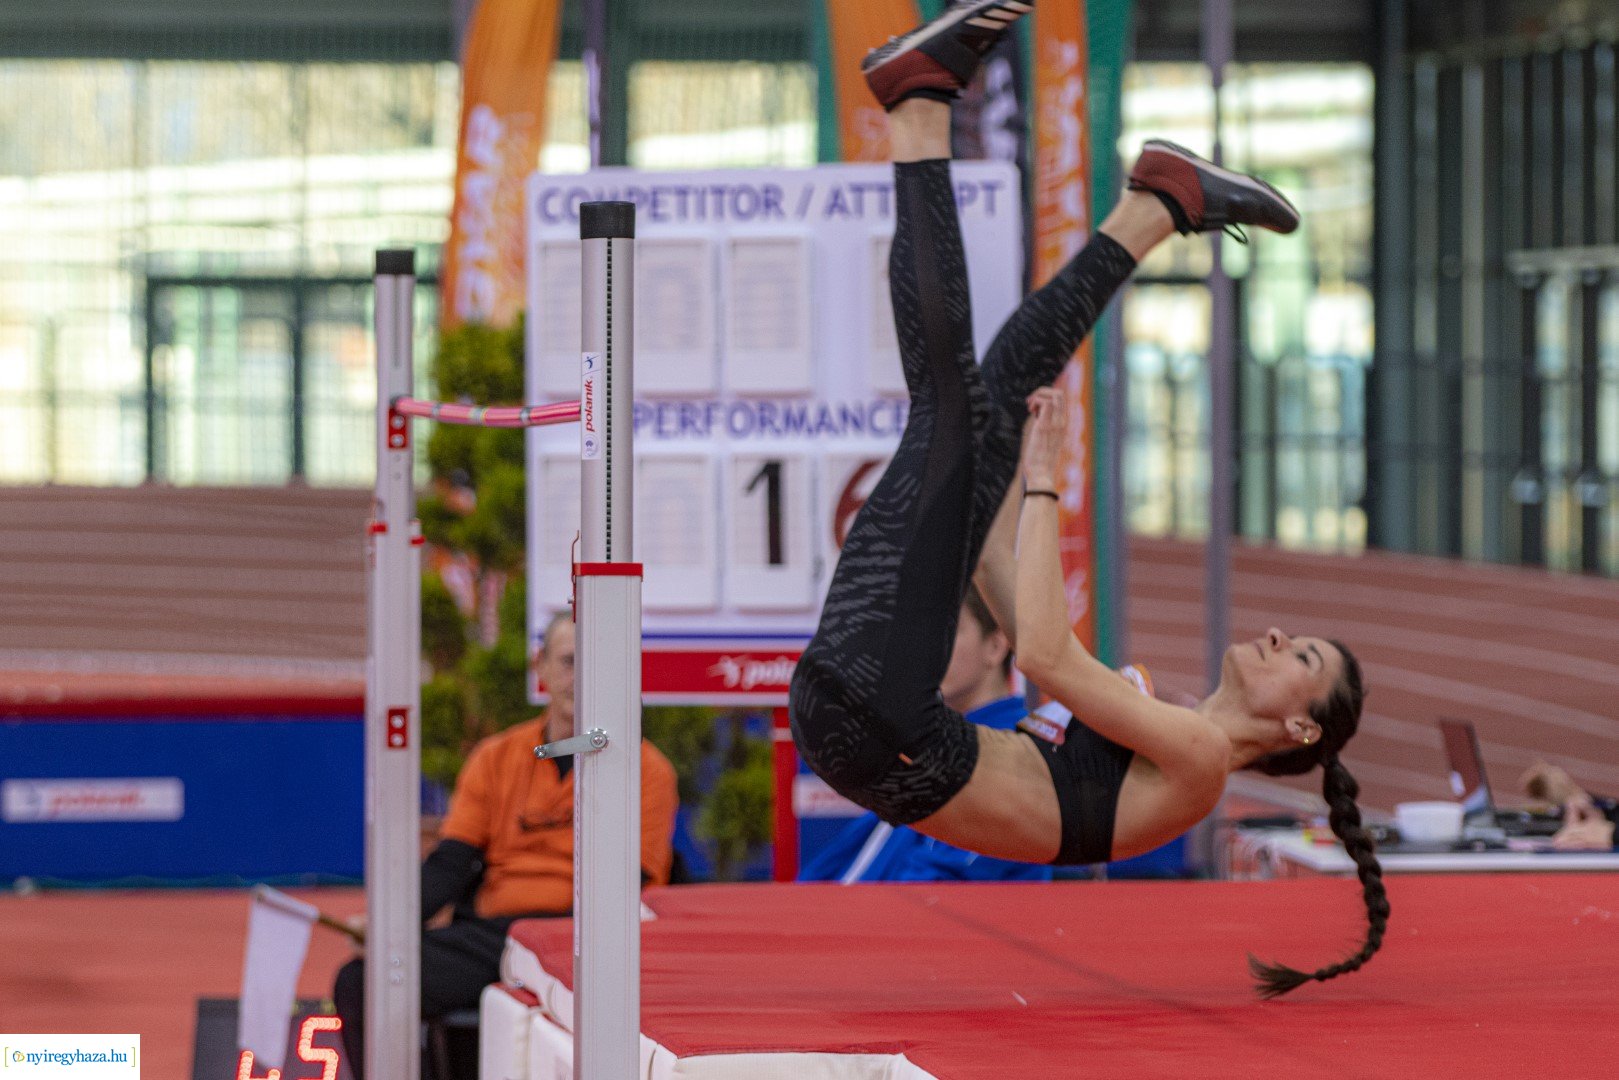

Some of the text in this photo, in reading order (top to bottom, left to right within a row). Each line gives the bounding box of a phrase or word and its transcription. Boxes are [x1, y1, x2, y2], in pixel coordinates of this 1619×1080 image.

[823, 181, 1003, 217] ATTPT
[584, 379, 595, 432] polanik
[744, 461, 783, 566] 1
